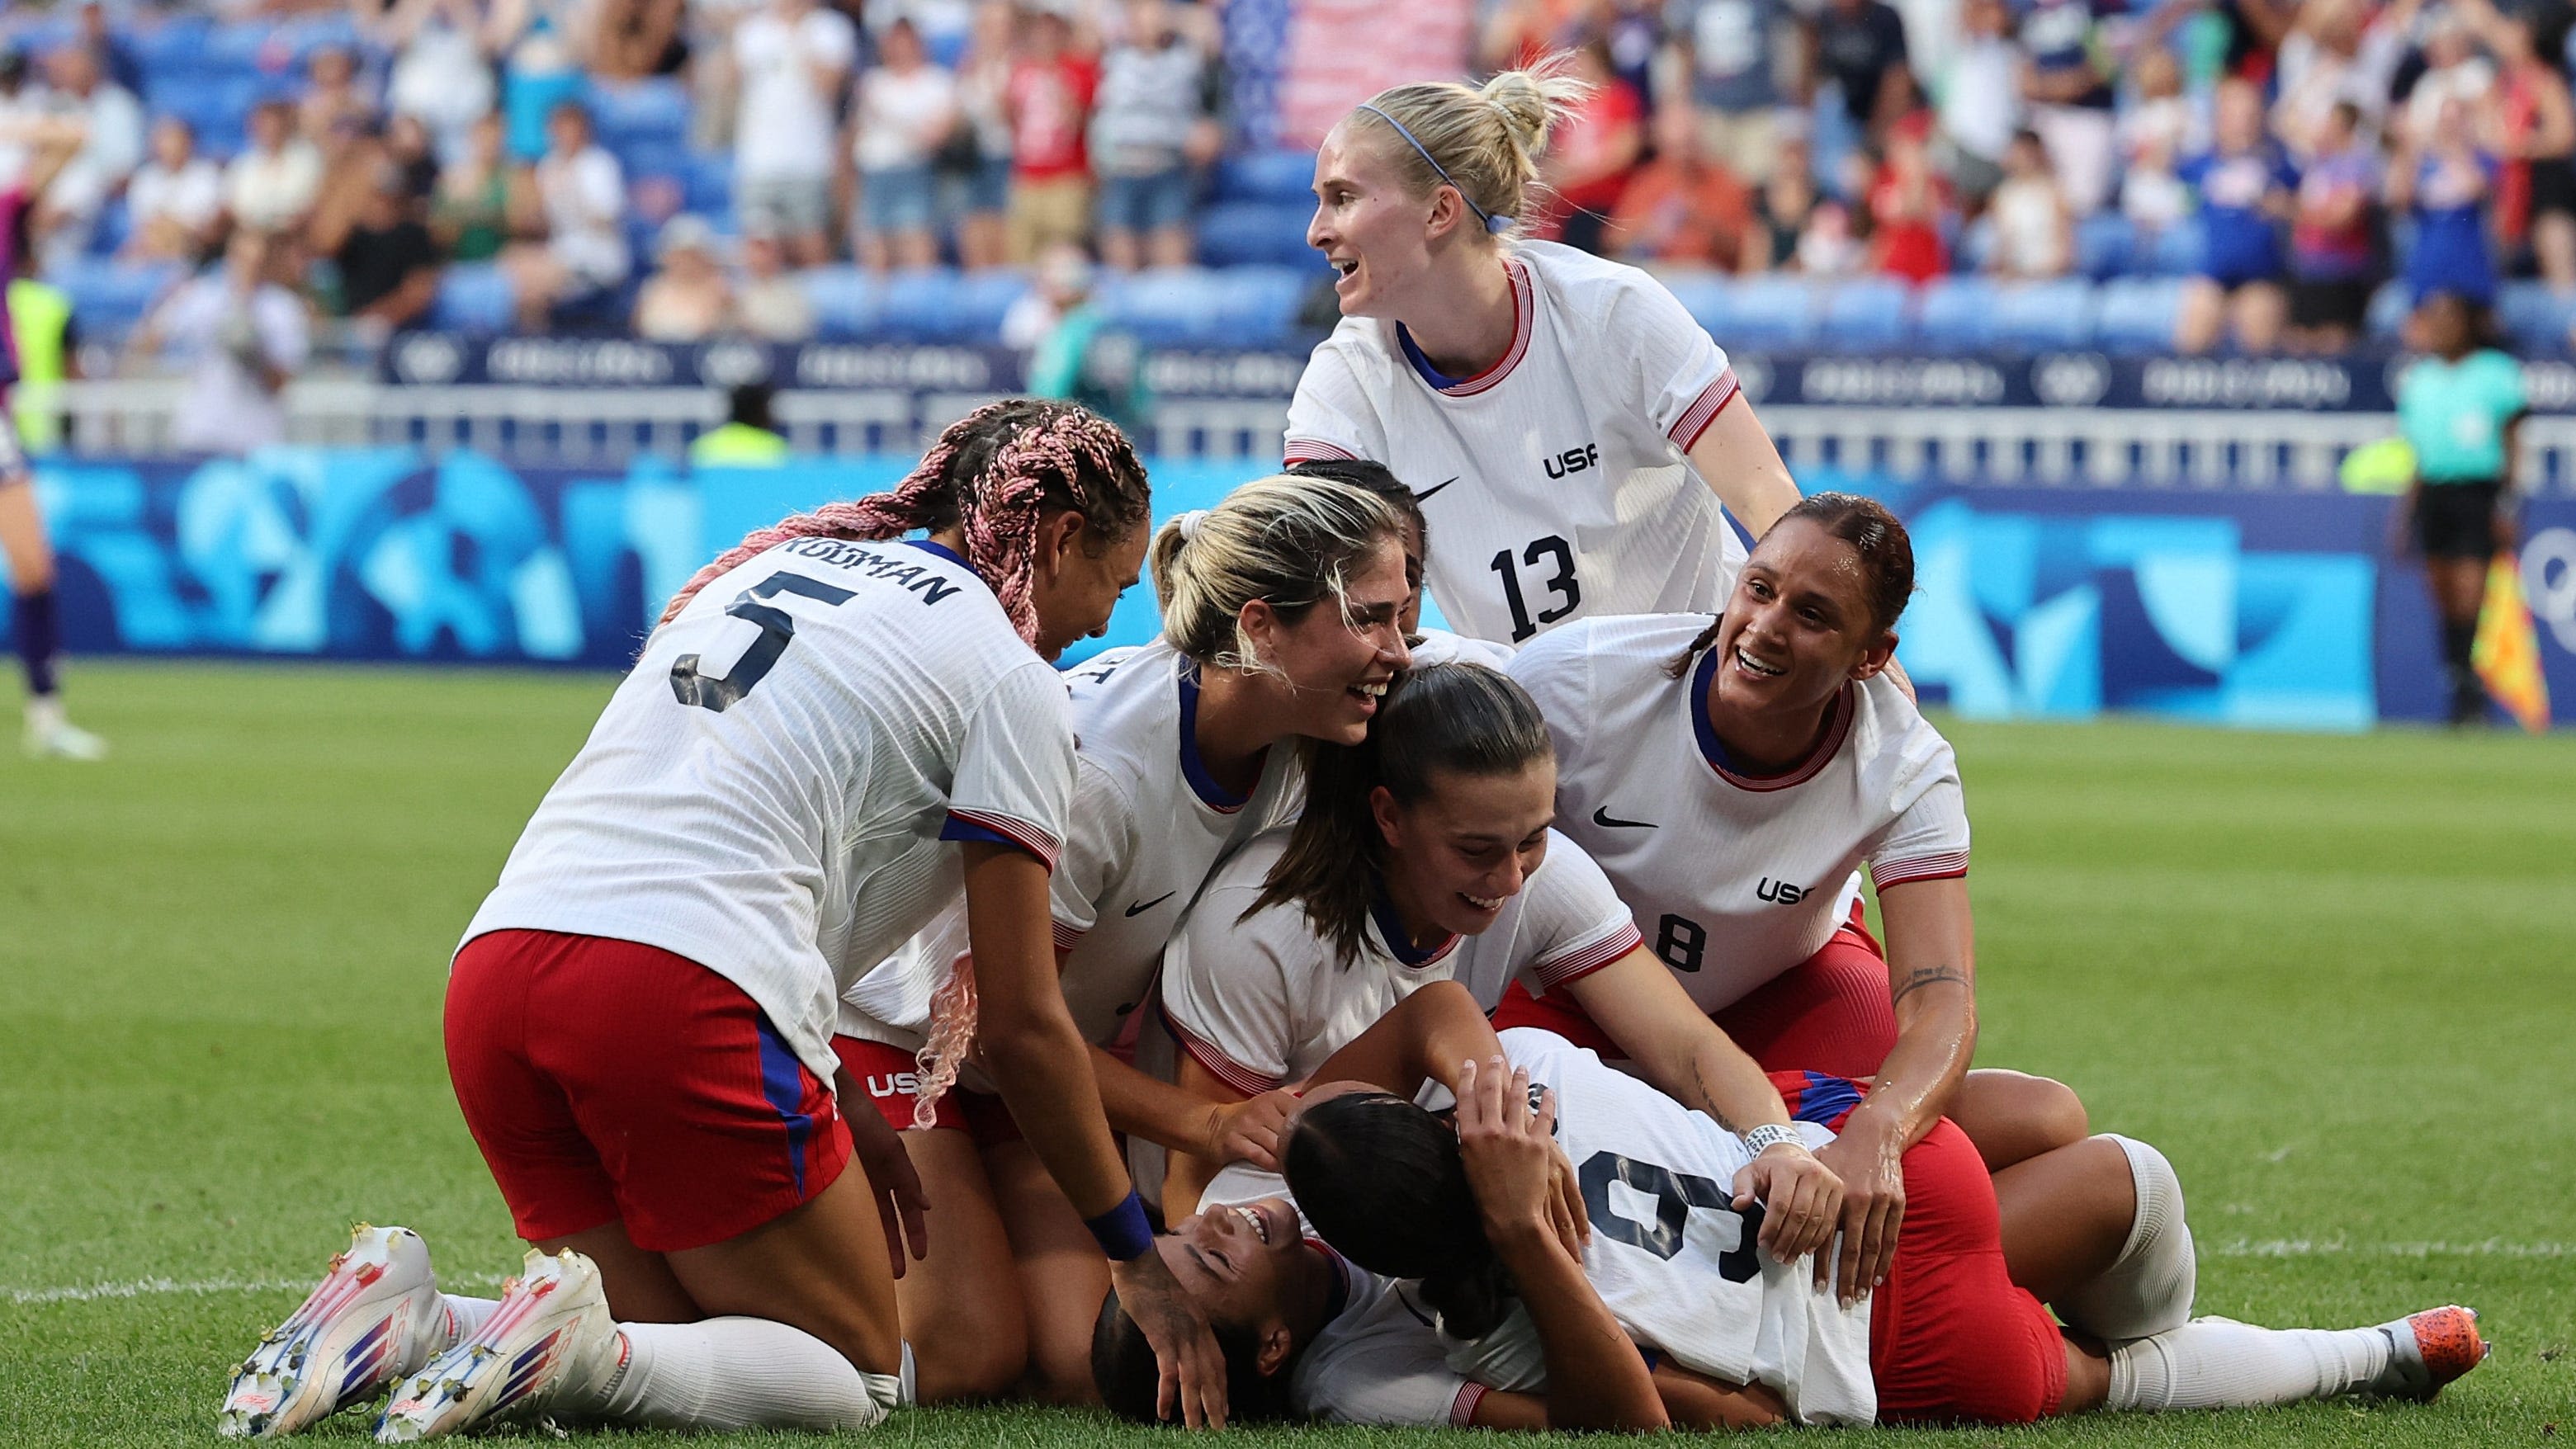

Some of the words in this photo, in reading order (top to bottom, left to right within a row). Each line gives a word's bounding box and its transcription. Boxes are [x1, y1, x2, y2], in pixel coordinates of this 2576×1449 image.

[1491, 535, 1581, 644] 13
[669, 570, 859, 713] 5
[1656, 913, 1707, 973] 8
[867, 1073, 921, 1097] US
